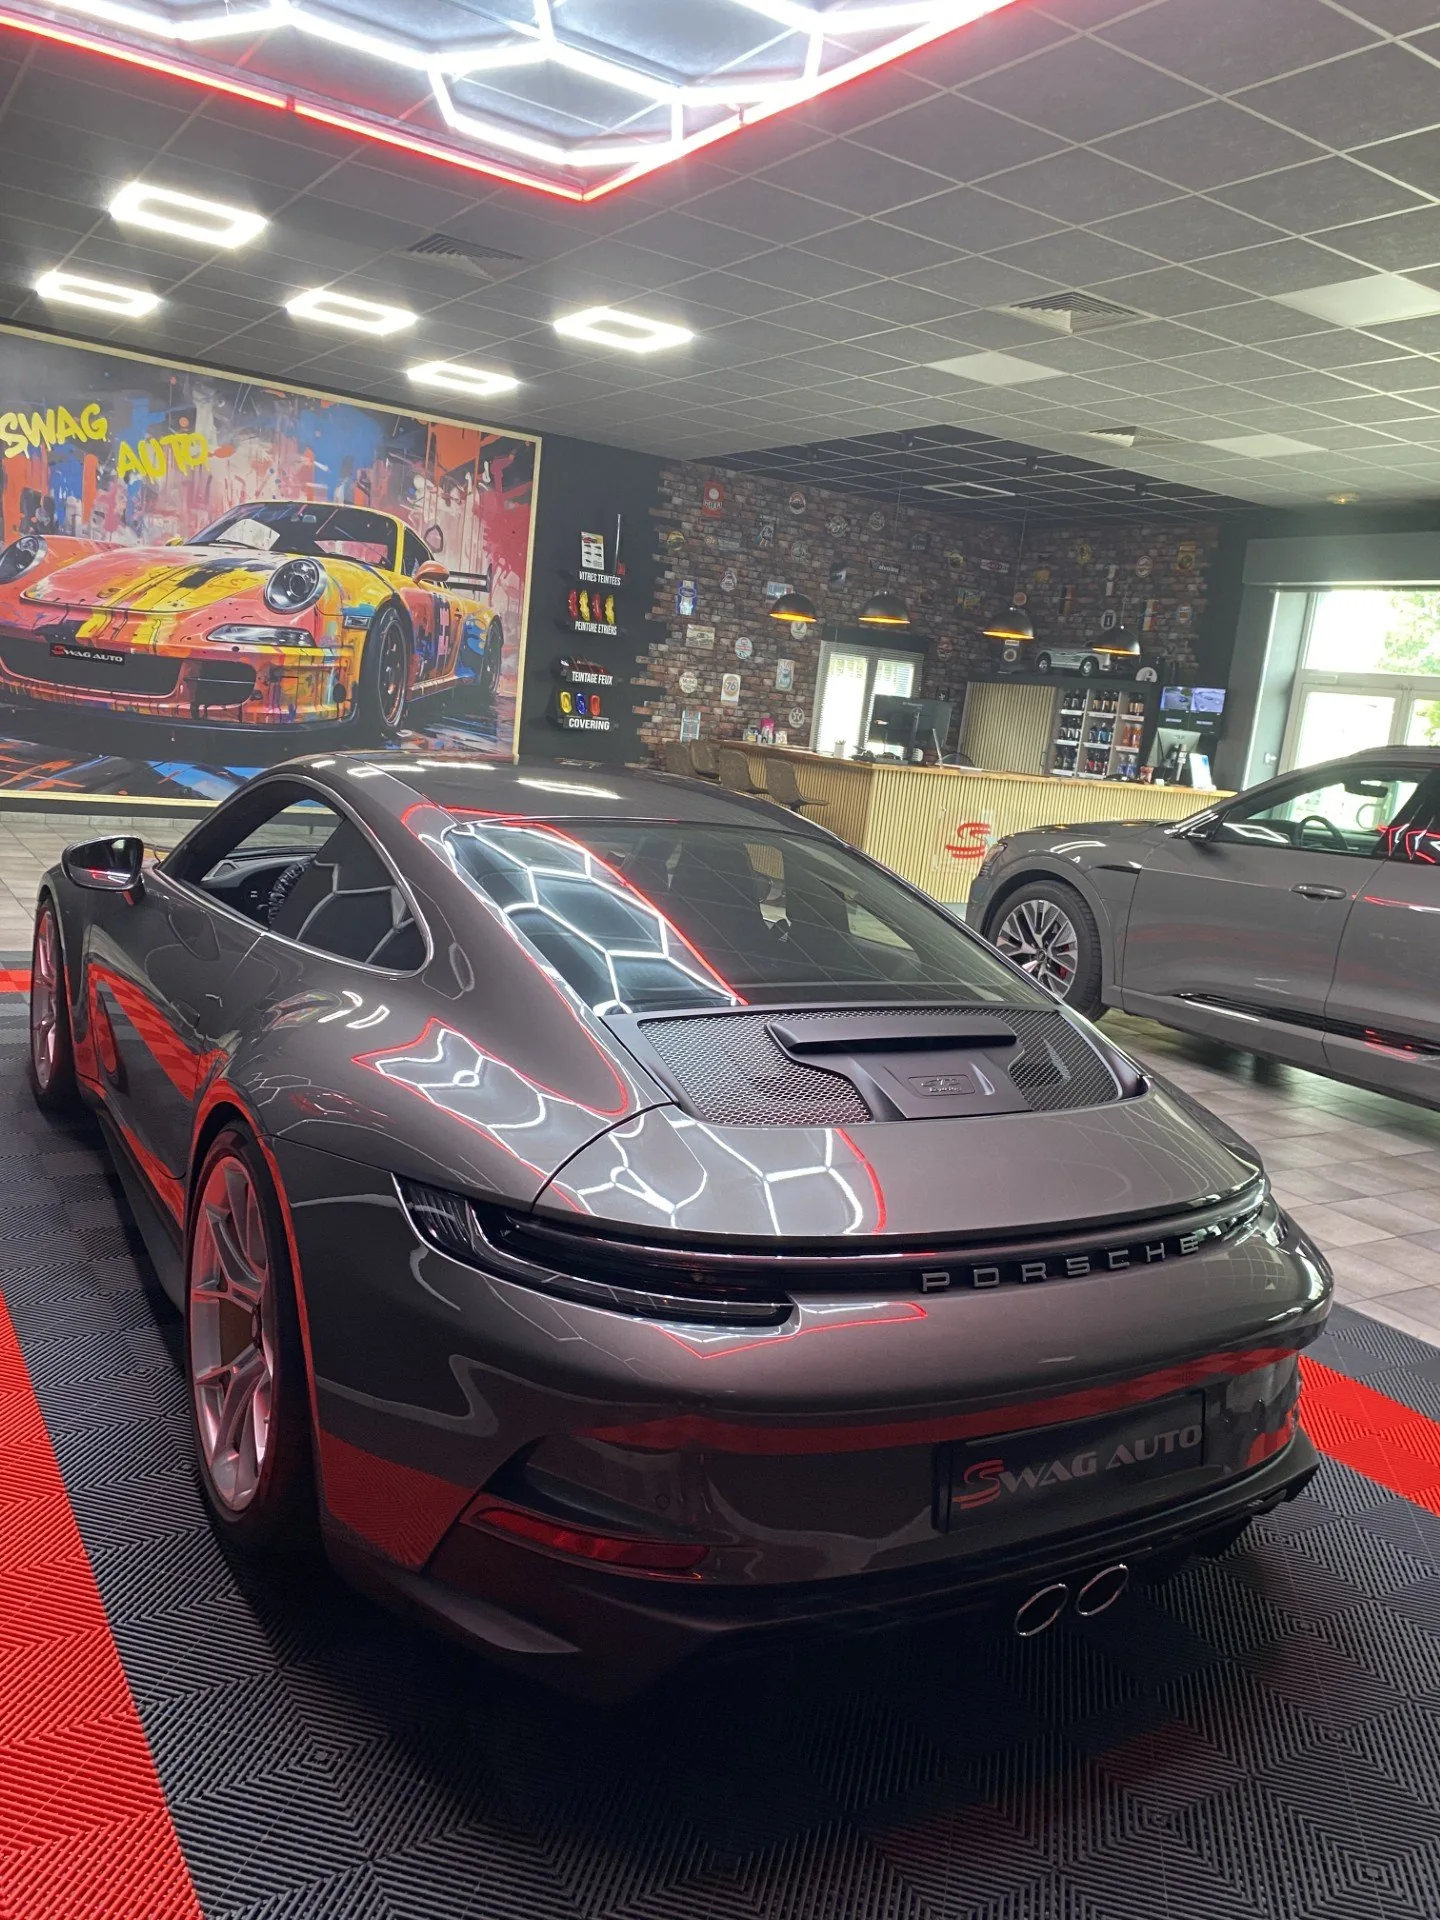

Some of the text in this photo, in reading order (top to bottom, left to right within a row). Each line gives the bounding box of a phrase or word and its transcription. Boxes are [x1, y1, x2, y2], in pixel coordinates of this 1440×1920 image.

[0, 403, 108, 459] SWAG
[116, 432, 210, 484] AUTO
[579, 571, 597, 582] VITRES
[574, 621, 598, 633] PEINTURE
[51, 644, 123, 662] SWAG AUTO
[572, 671, 613, 686] TEINTAGE FEUX
[725, 682, 737, 691] 76
[568, 718, 610, 731] COVERING
[921, 1234, 1200, 1293] PORSCHE
[952, 1425, 1202, 1510] SWAG AUTO
